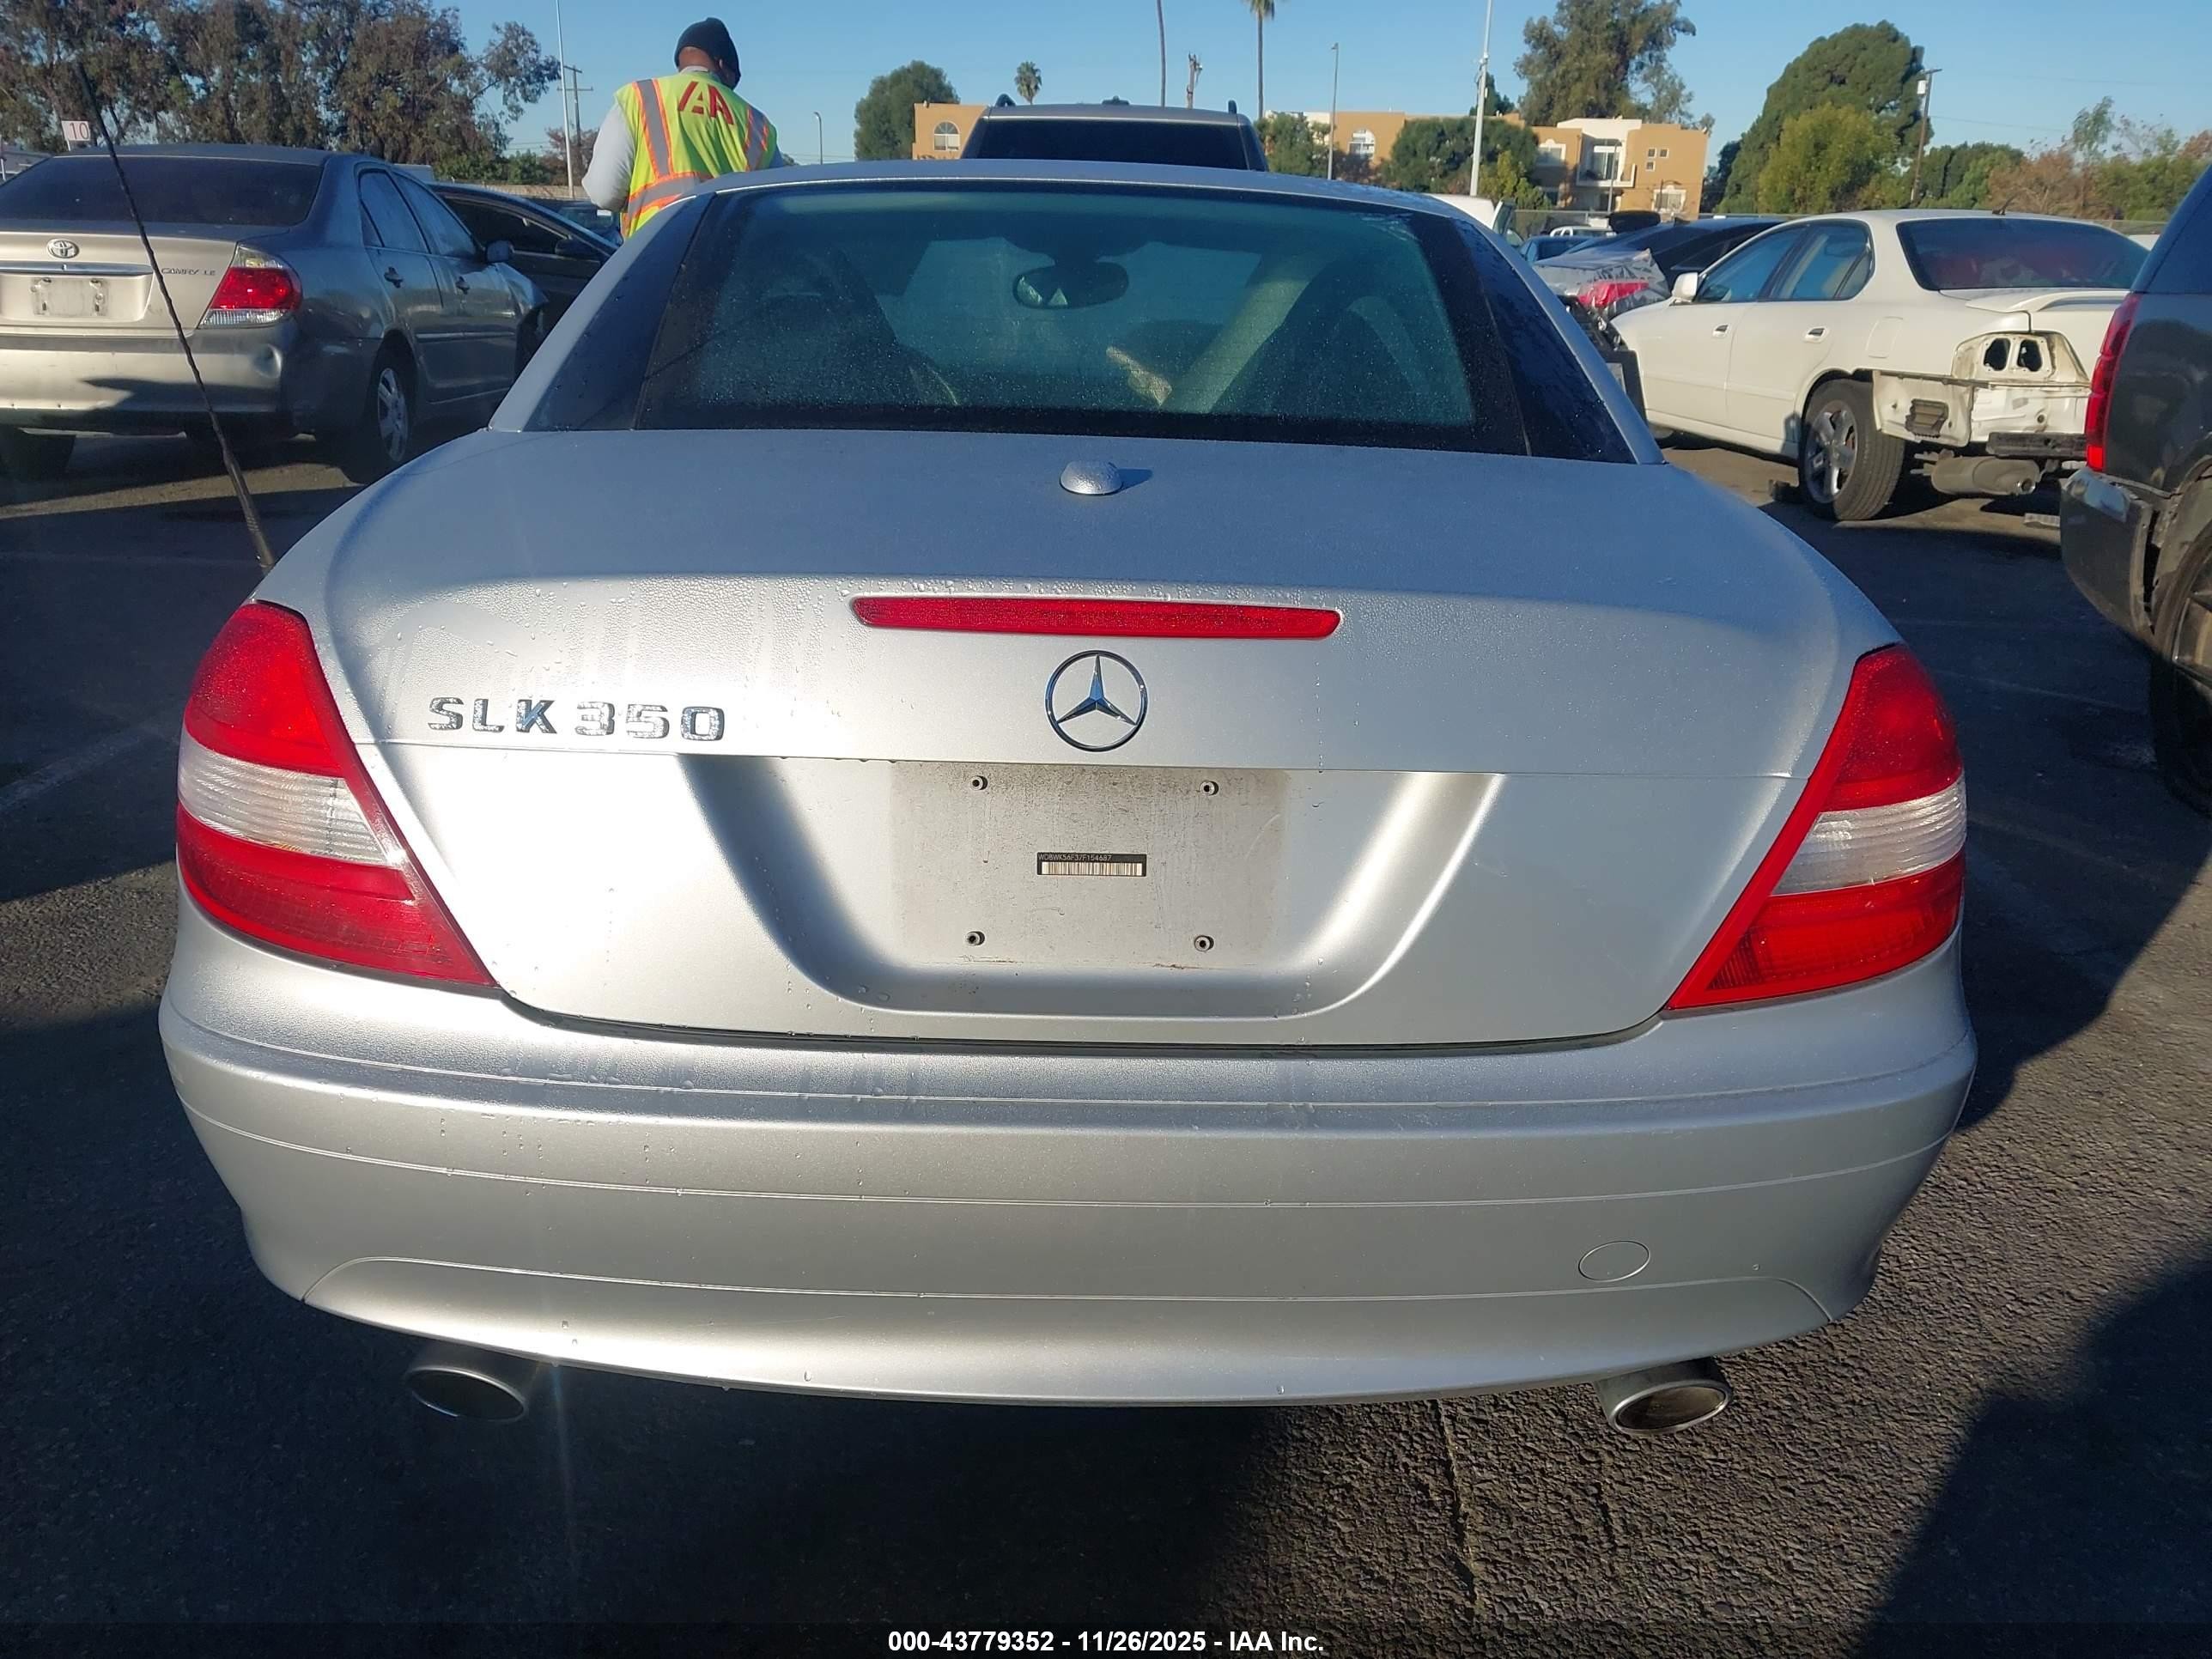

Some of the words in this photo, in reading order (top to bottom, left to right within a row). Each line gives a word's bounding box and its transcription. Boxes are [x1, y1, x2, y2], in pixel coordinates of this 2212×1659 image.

[70, 122, 89, 139] 10
[427, 696, 557, 734] SLK
[574, 701, 726, 742] 350
